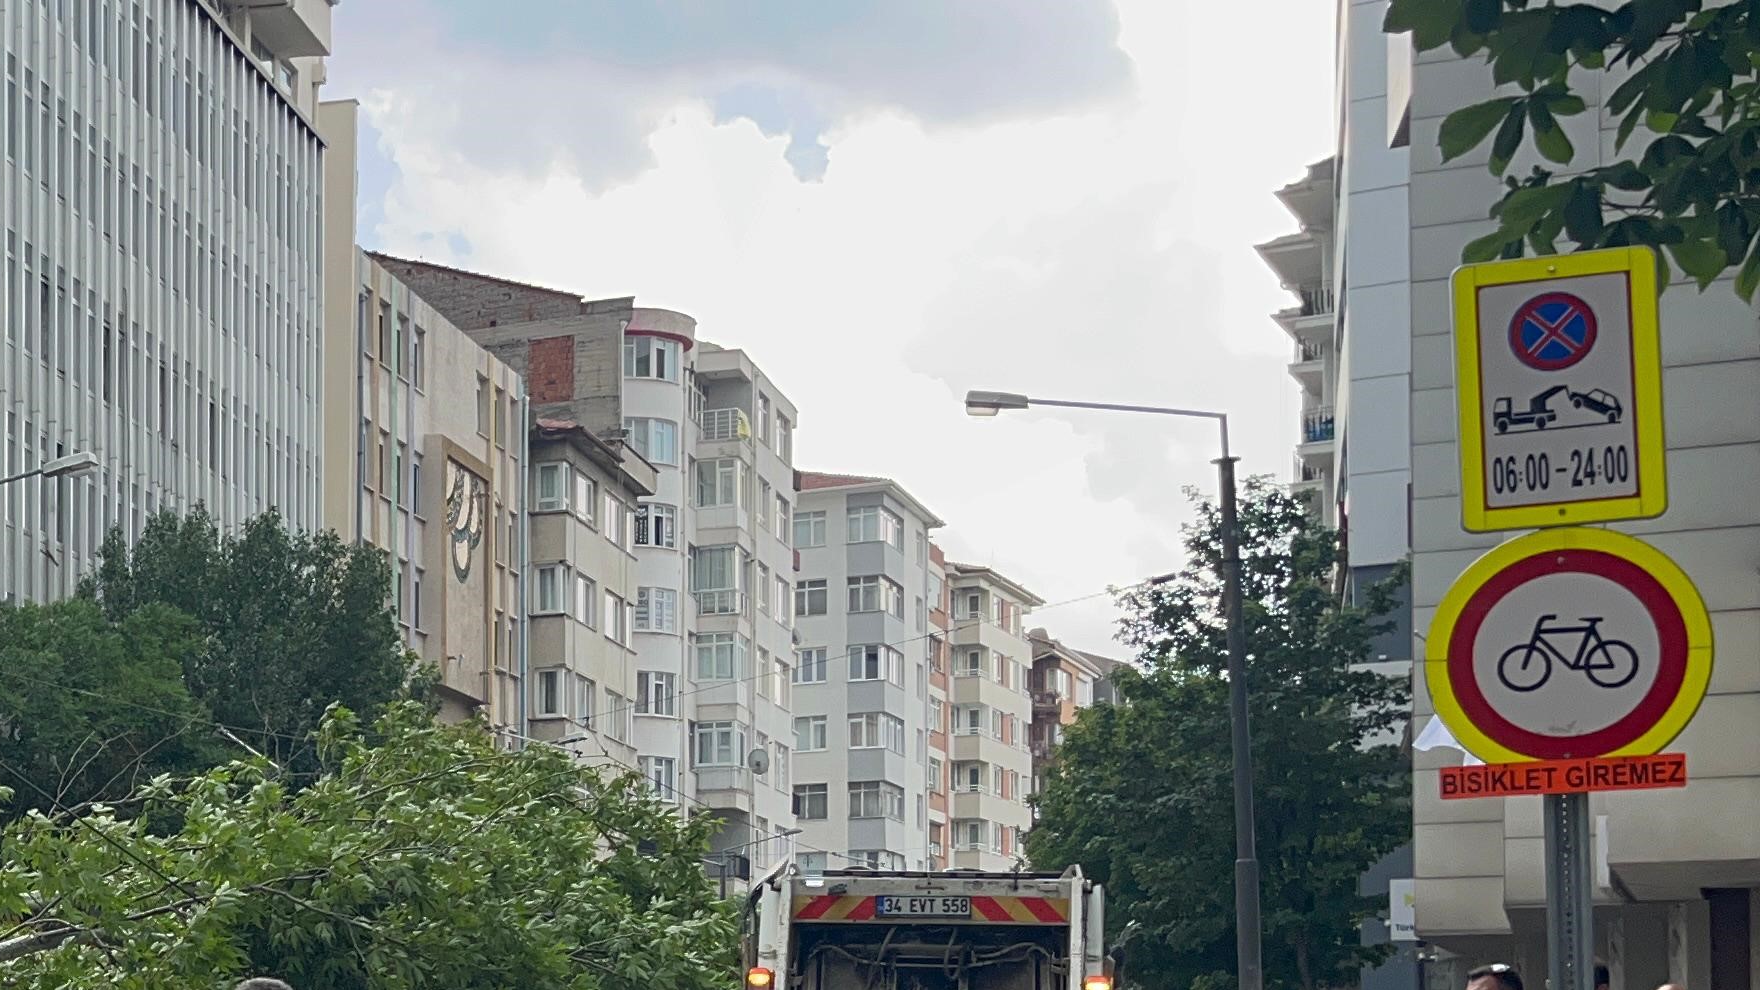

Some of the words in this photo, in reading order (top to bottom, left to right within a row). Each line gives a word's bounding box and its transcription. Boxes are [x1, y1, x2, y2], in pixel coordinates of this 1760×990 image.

[1493, 454, 1549, 494] 06:00
[1570, 444, 1628, 488] 24:00
[1442, 764, 1558, 795] BİSİKLET
[1566, 759, 1686, 788] GİREMEZ
[884, 898, 902, 913] 34
[909, 898, 937, 913] EVT
[942, 898, 968, 913] 558
